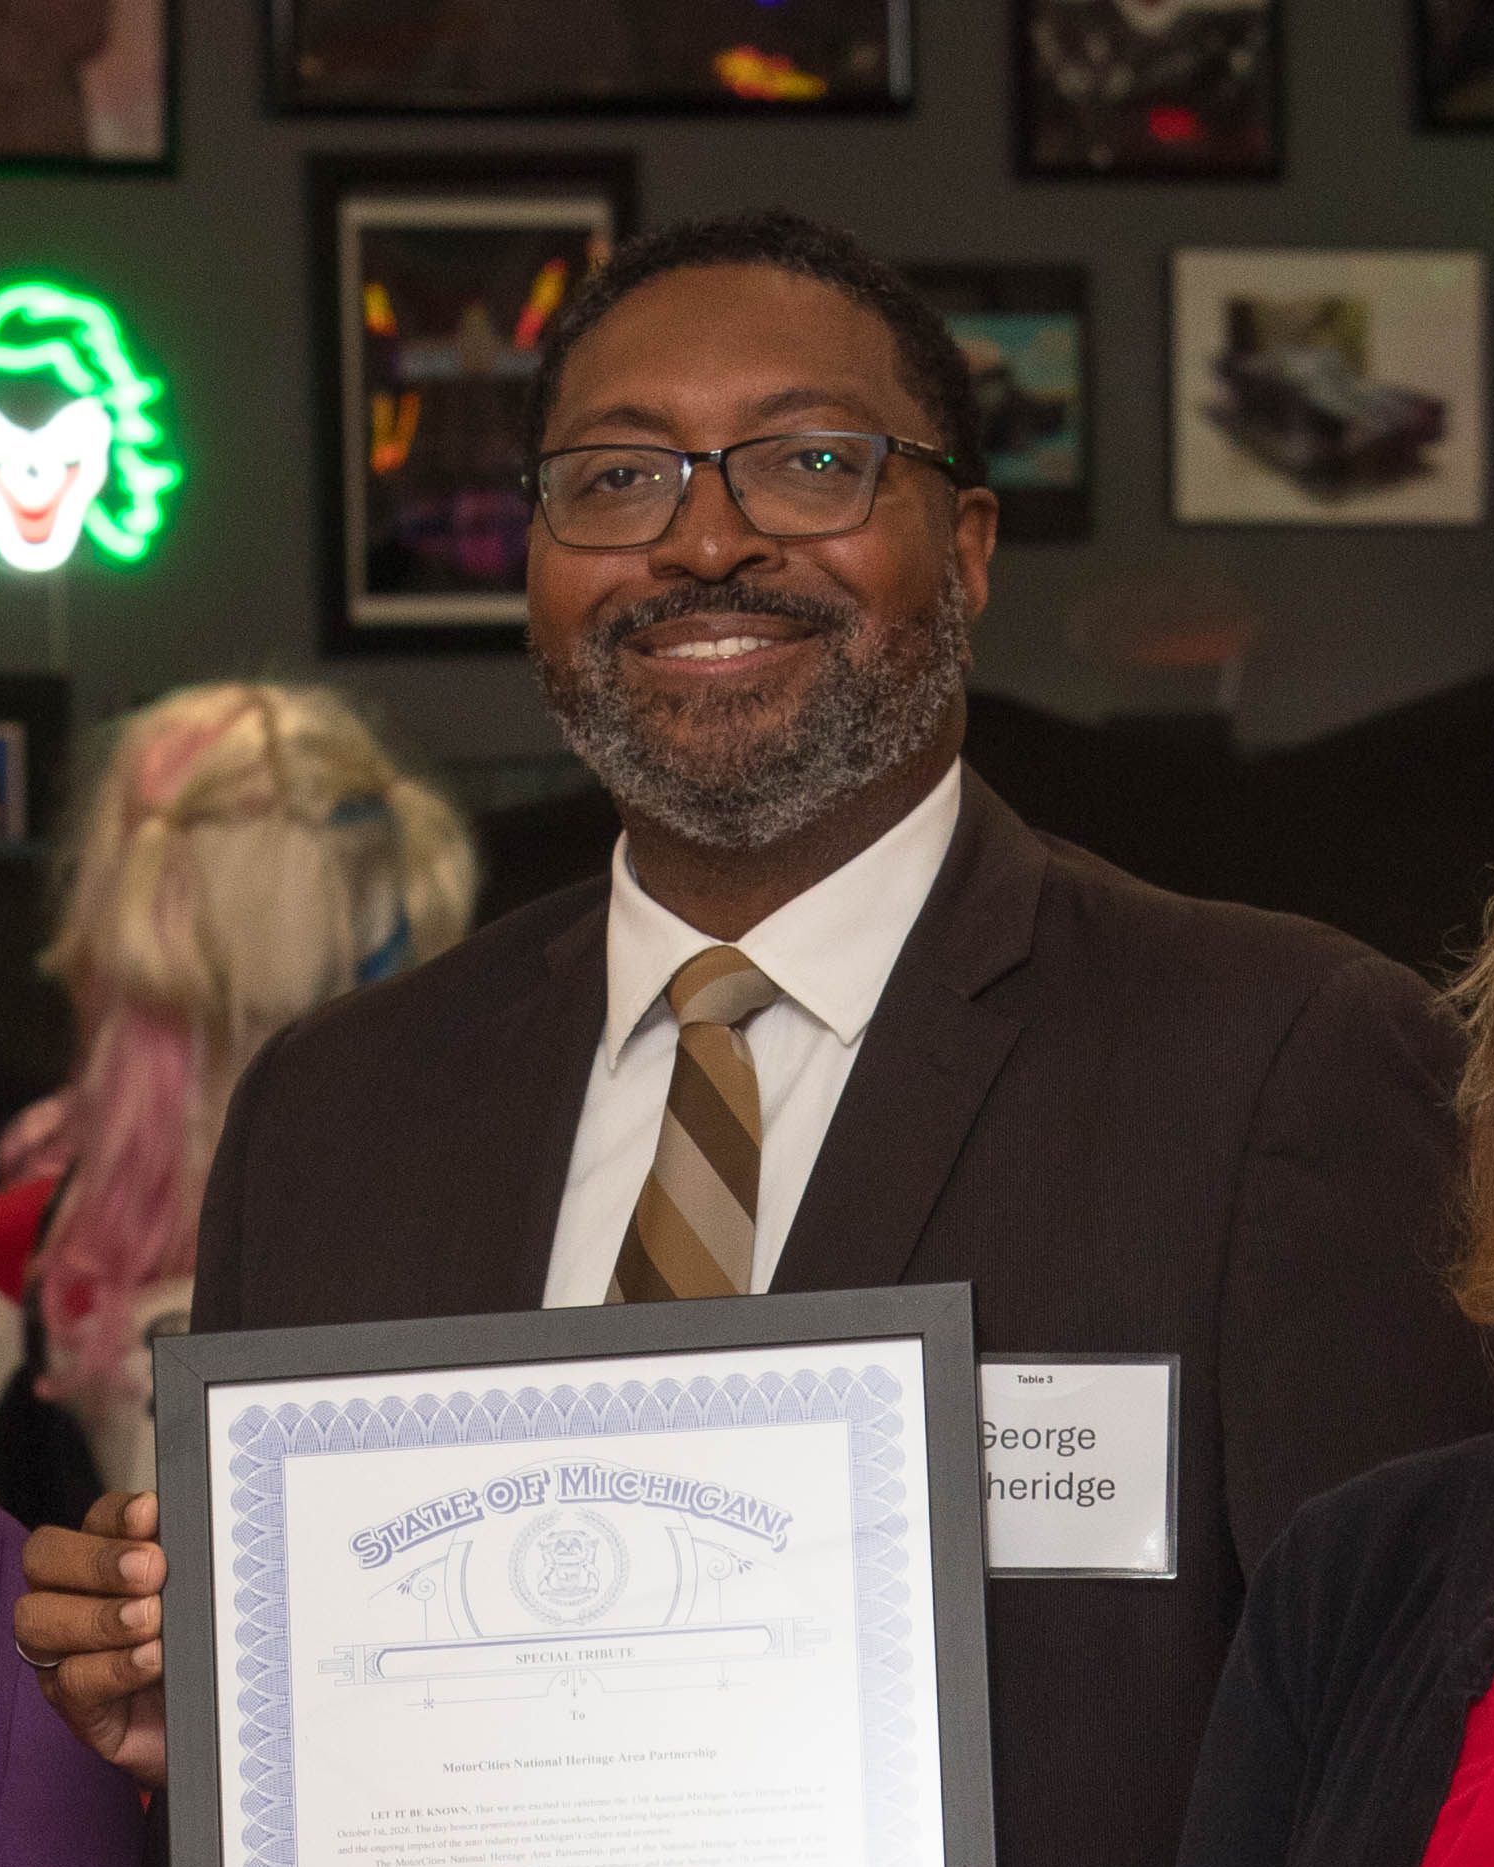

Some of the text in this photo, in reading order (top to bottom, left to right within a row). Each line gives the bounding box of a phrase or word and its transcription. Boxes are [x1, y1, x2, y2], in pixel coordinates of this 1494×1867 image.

[1016, 1374, 1054, 1385] Table 3
[982, 1420, 1096, 1458] George
[986, 1471, 1116, 1508] heridge
[349, 1462, 794, 1569] STATE OF MICHIGAN,
[515, 1646, 635, 1665] SPECIAL TRIBUTE
[569, 1709, 586, 1722] To
[442, 1745, 718, 1774] MotorCities National Heritage Area Partnership
